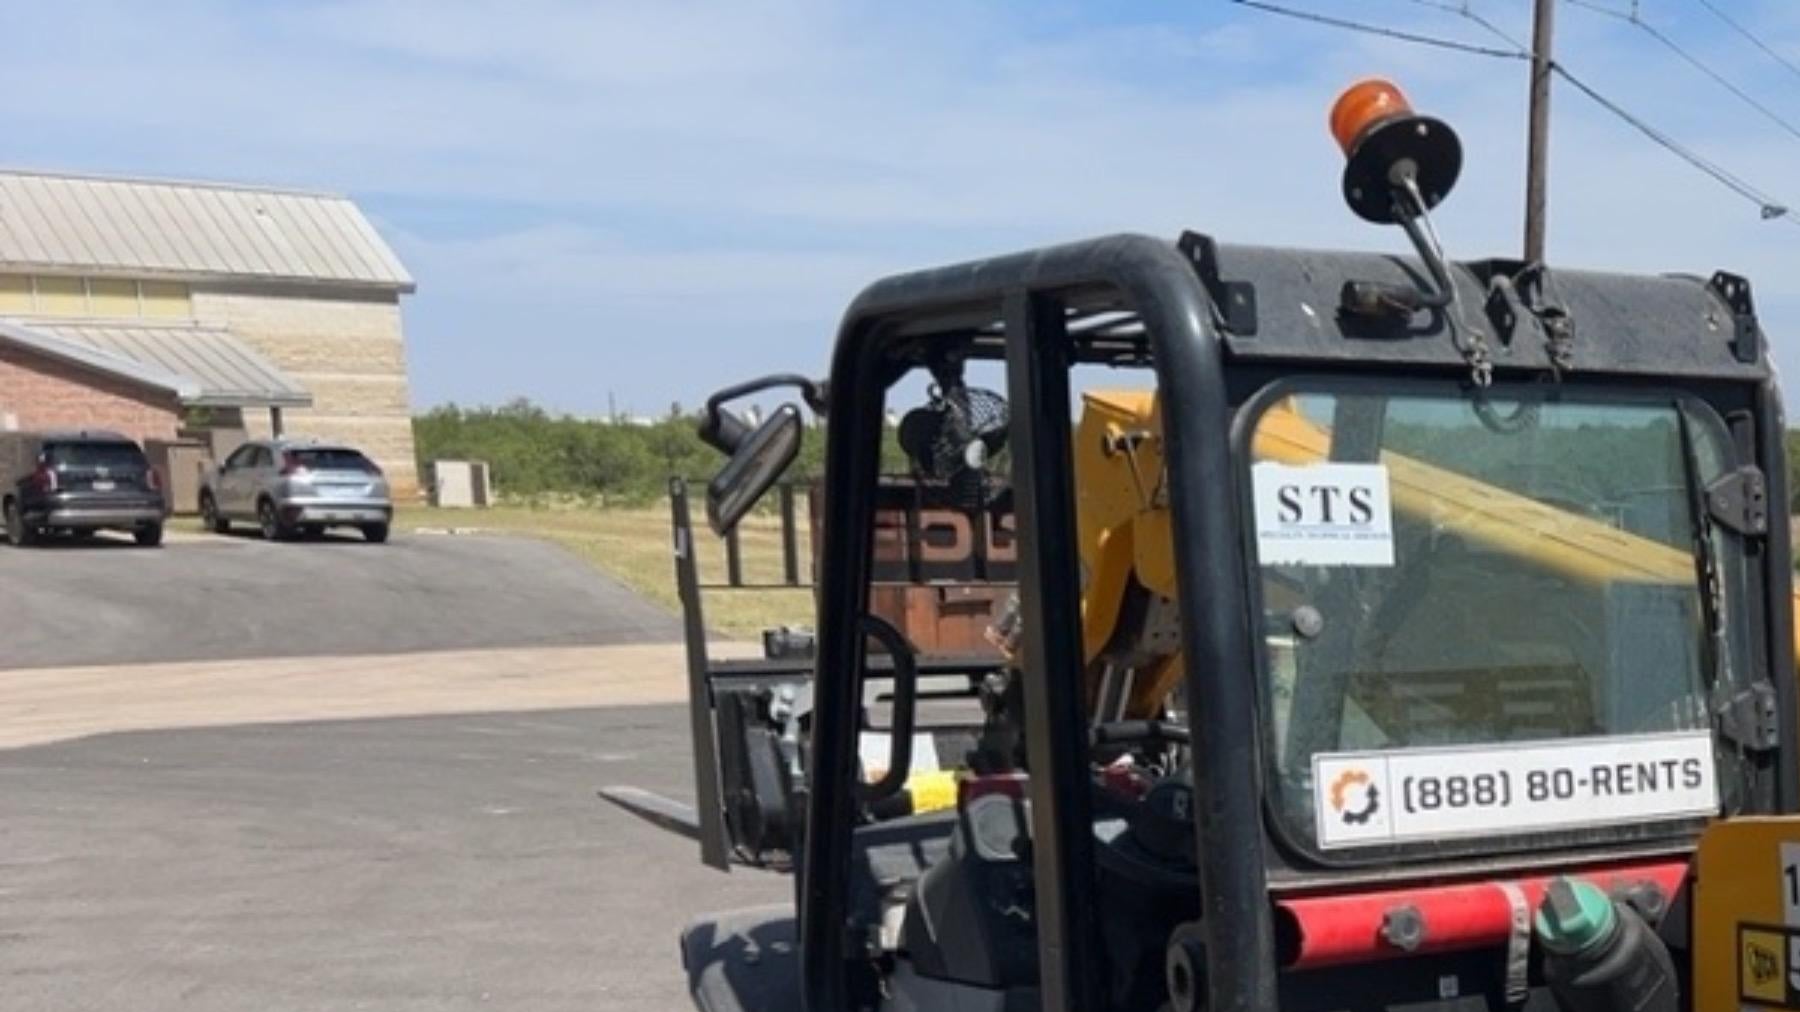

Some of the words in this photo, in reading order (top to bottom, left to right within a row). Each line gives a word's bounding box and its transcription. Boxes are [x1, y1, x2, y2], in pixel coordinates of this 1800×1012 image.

[1277, 484, 1374, 524] STS
[1403, 769, 1511, 813] (888)
[1526, 758, 1703, 802] 80-RENTS
